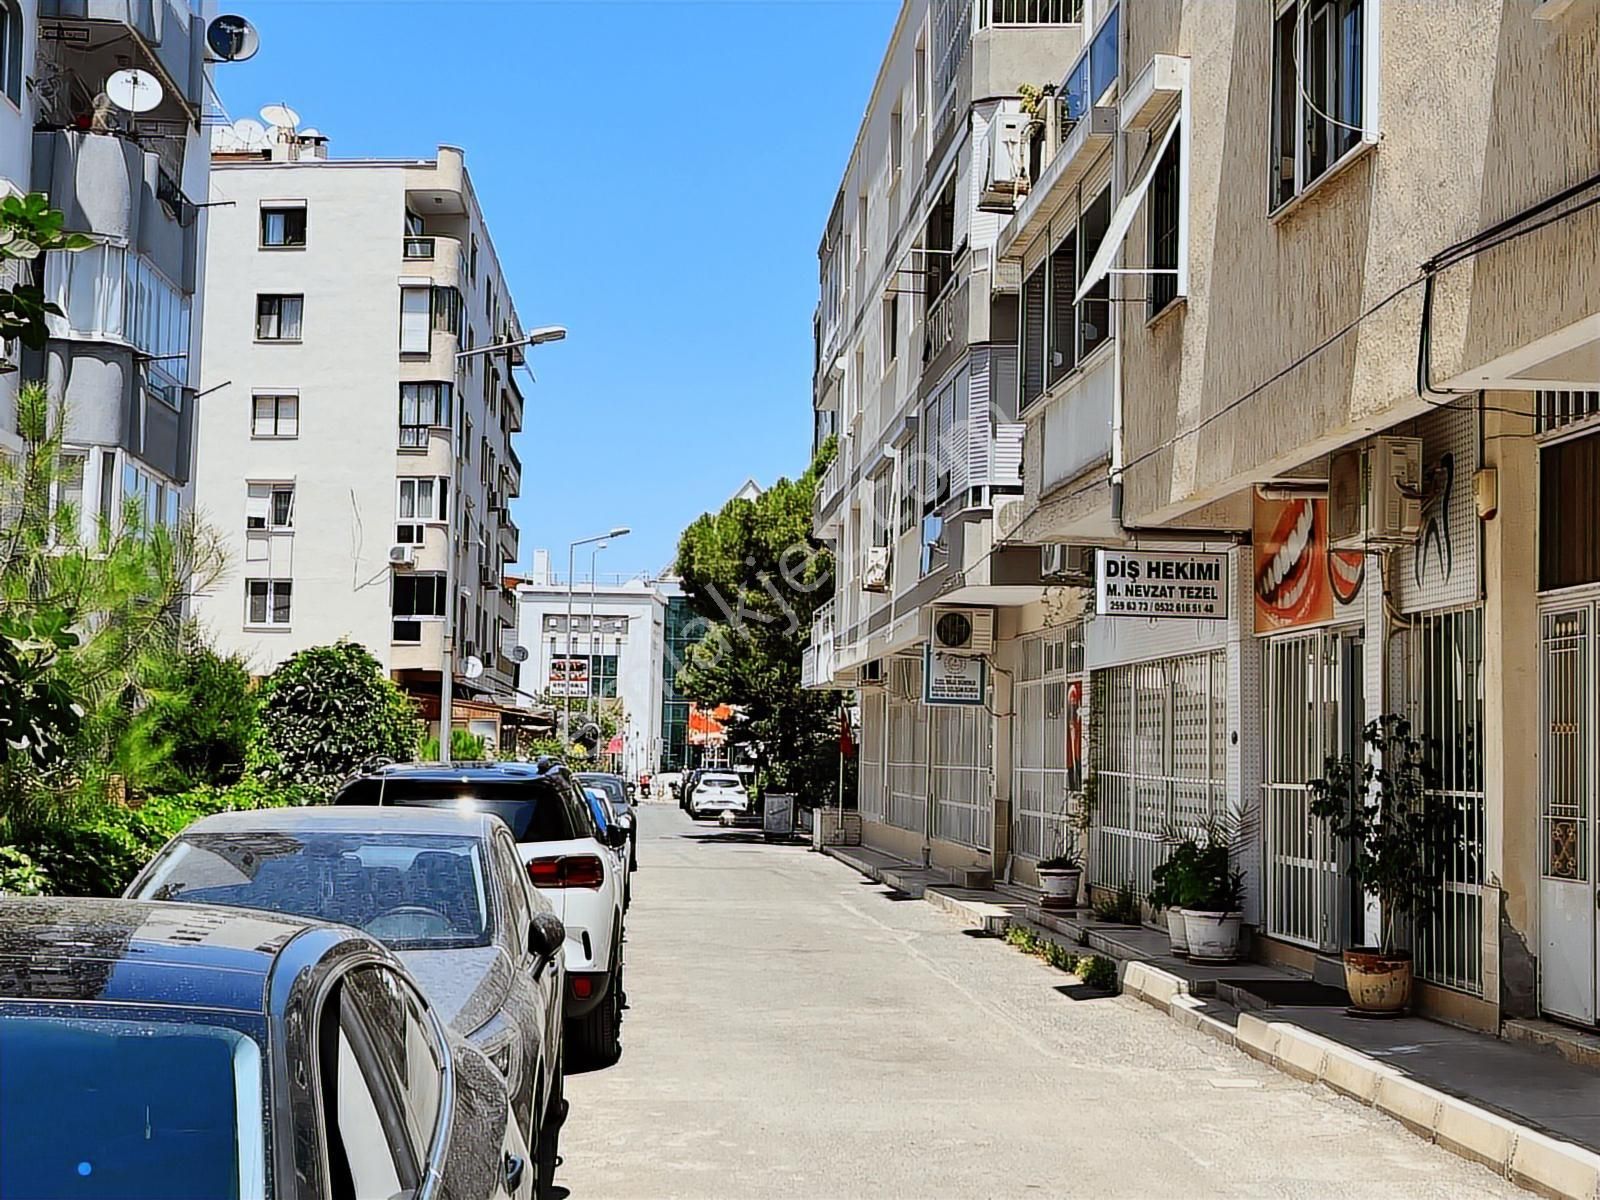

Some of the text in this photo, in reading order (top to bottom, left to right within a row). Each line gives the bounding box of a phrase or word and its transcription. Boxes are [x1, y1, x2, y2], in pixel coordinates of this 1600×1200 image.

[1106, 555, 1219, 583] DİŞ HEKİMİ
[1106, 584, 1218, 600] M. NEVZAT TEZEL
[1110, 601, 1124, 610] 259
[1138, 602, 1148, 611] 73
[1155, 602, 1174, 611] 0532
